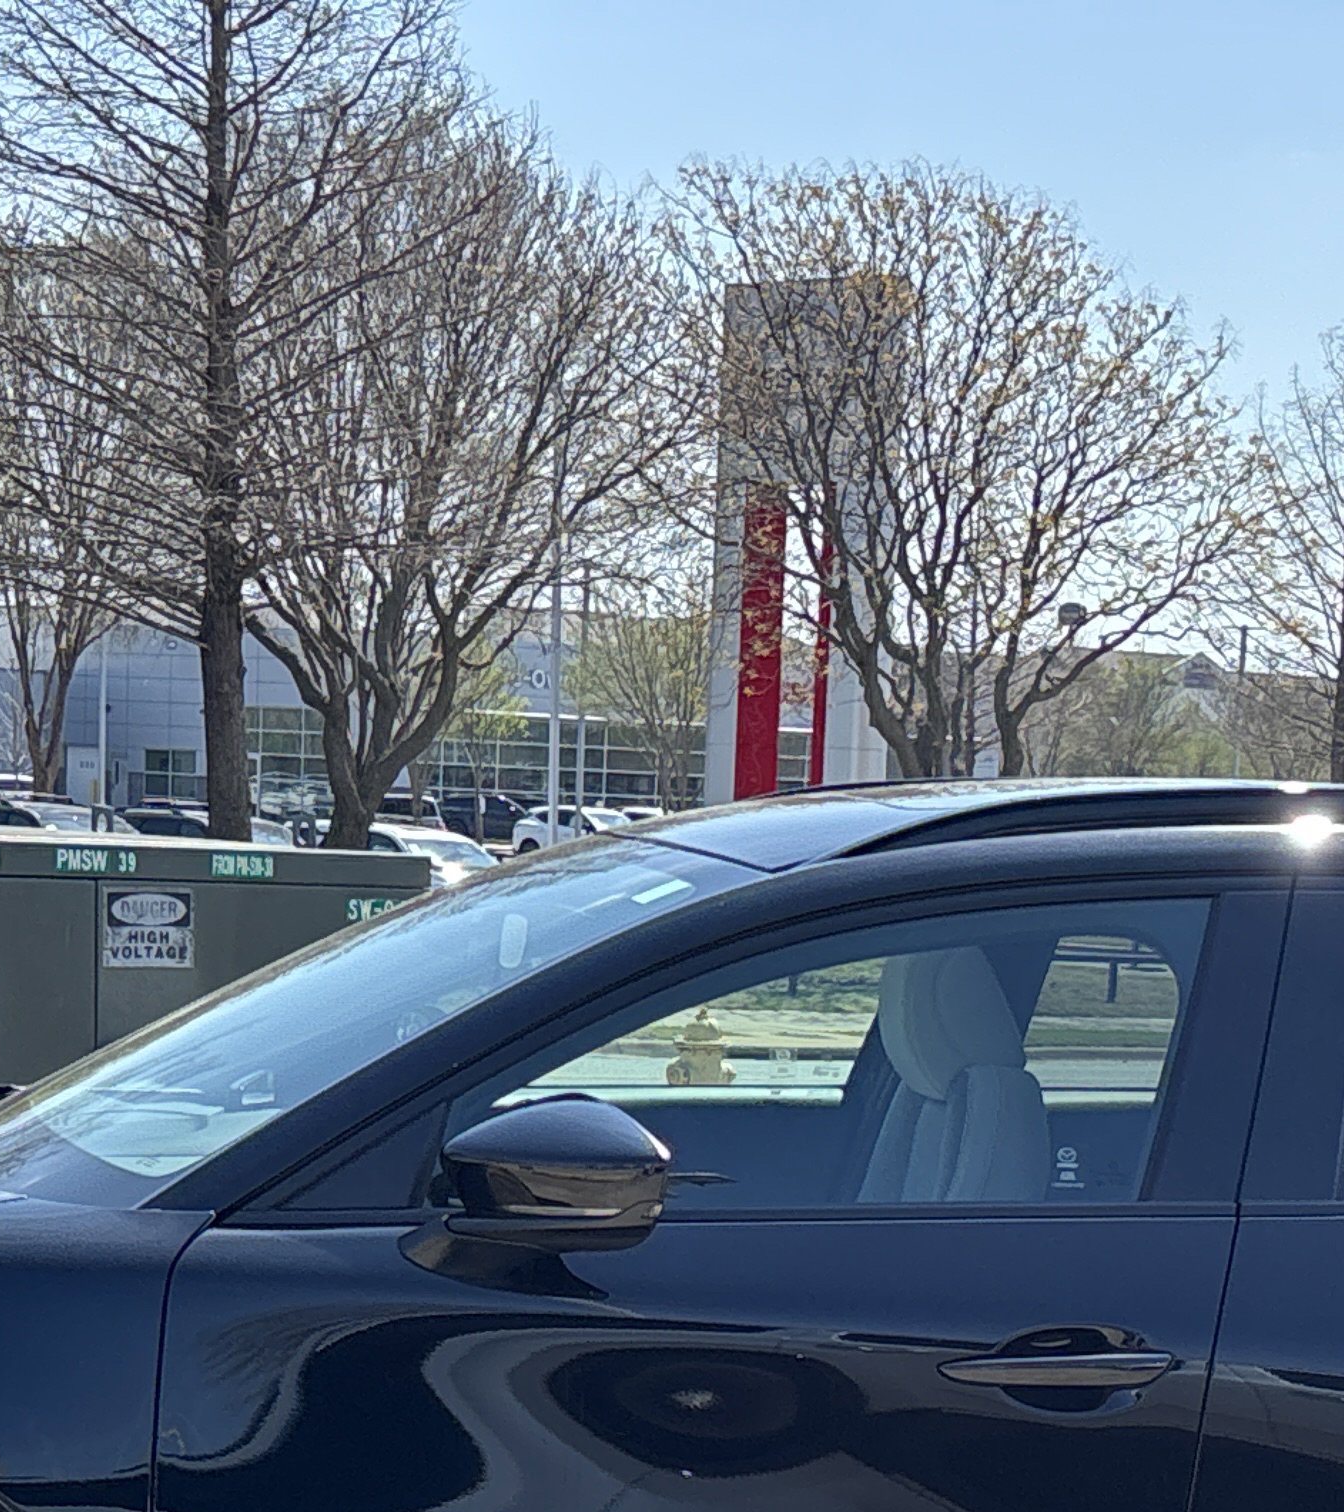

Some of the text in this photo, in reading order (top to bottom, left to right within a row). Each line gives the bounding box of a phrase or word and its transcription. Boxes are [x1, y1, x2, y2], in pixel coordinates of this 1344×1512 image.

[56, 848, 137, 872] PMSW 39
[347, 899, 394, 920] SW-0
[128, 930, 170, 944] HIGH
[111, 945, 188, 960] VOLTAGE
